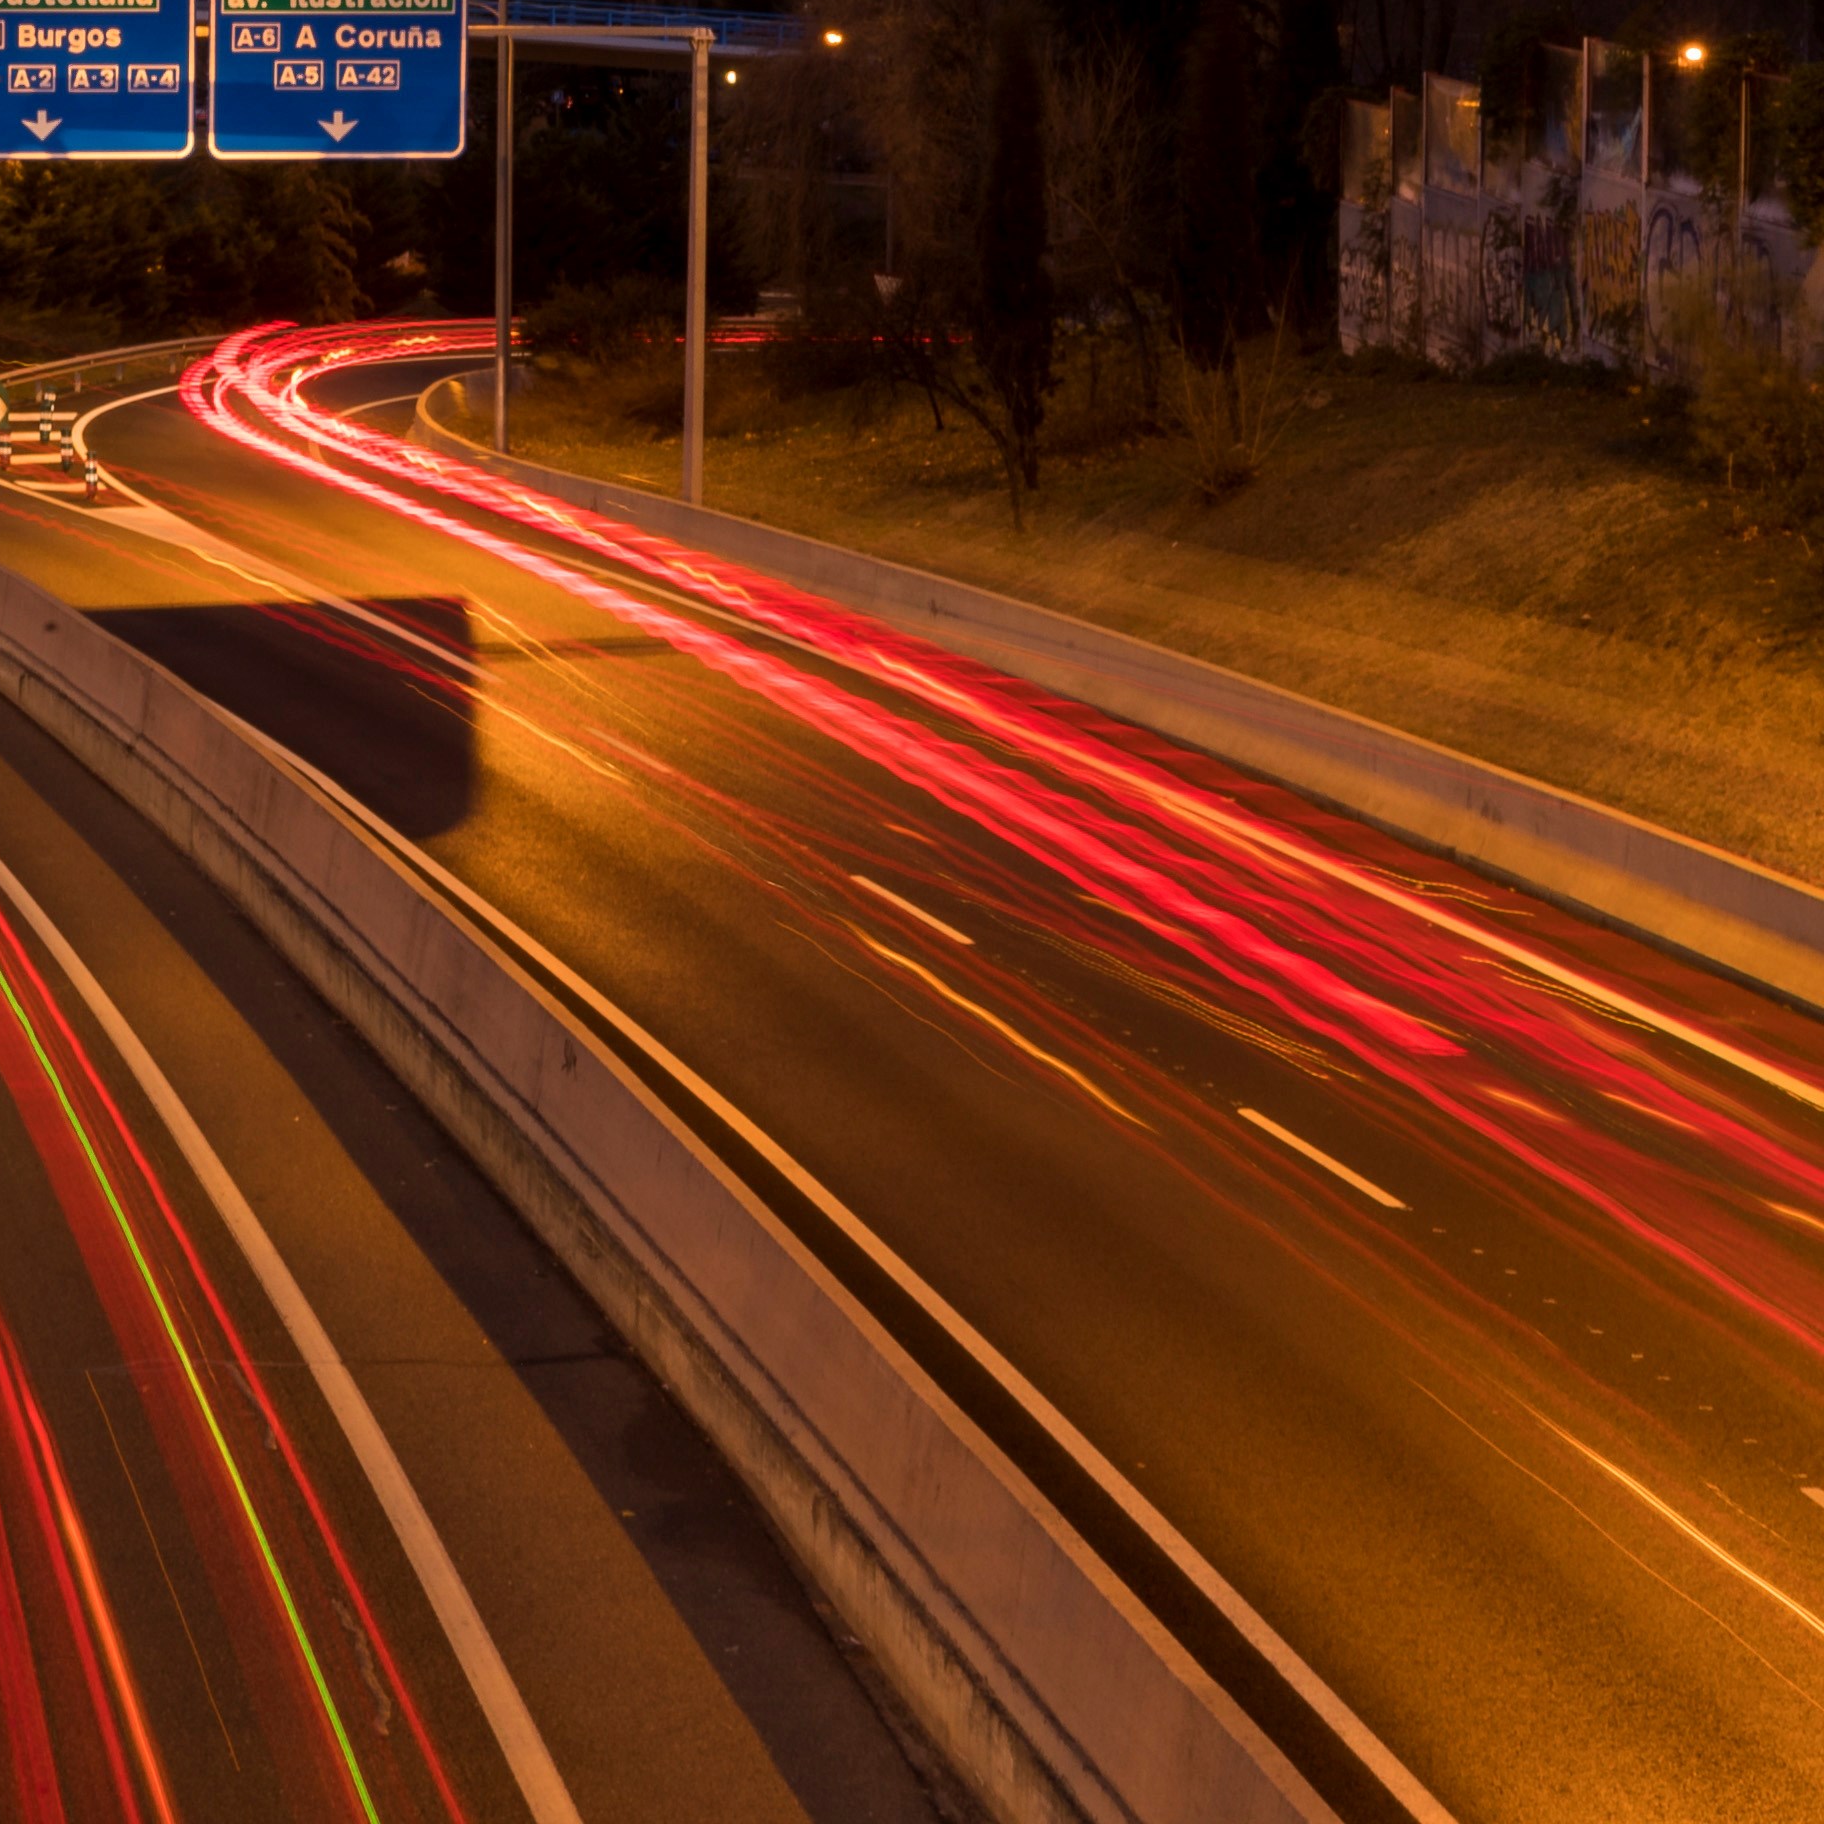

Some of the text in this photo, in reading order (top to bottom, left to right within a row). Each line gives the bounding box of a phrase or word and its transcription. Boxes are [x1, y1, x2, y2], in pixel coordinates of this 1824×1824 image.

[18, 24, 122, 54] Burgos
[237, 24, 441, 48] A-6 A Coruña
[279, 66, 395, 85] A-5 A-42
